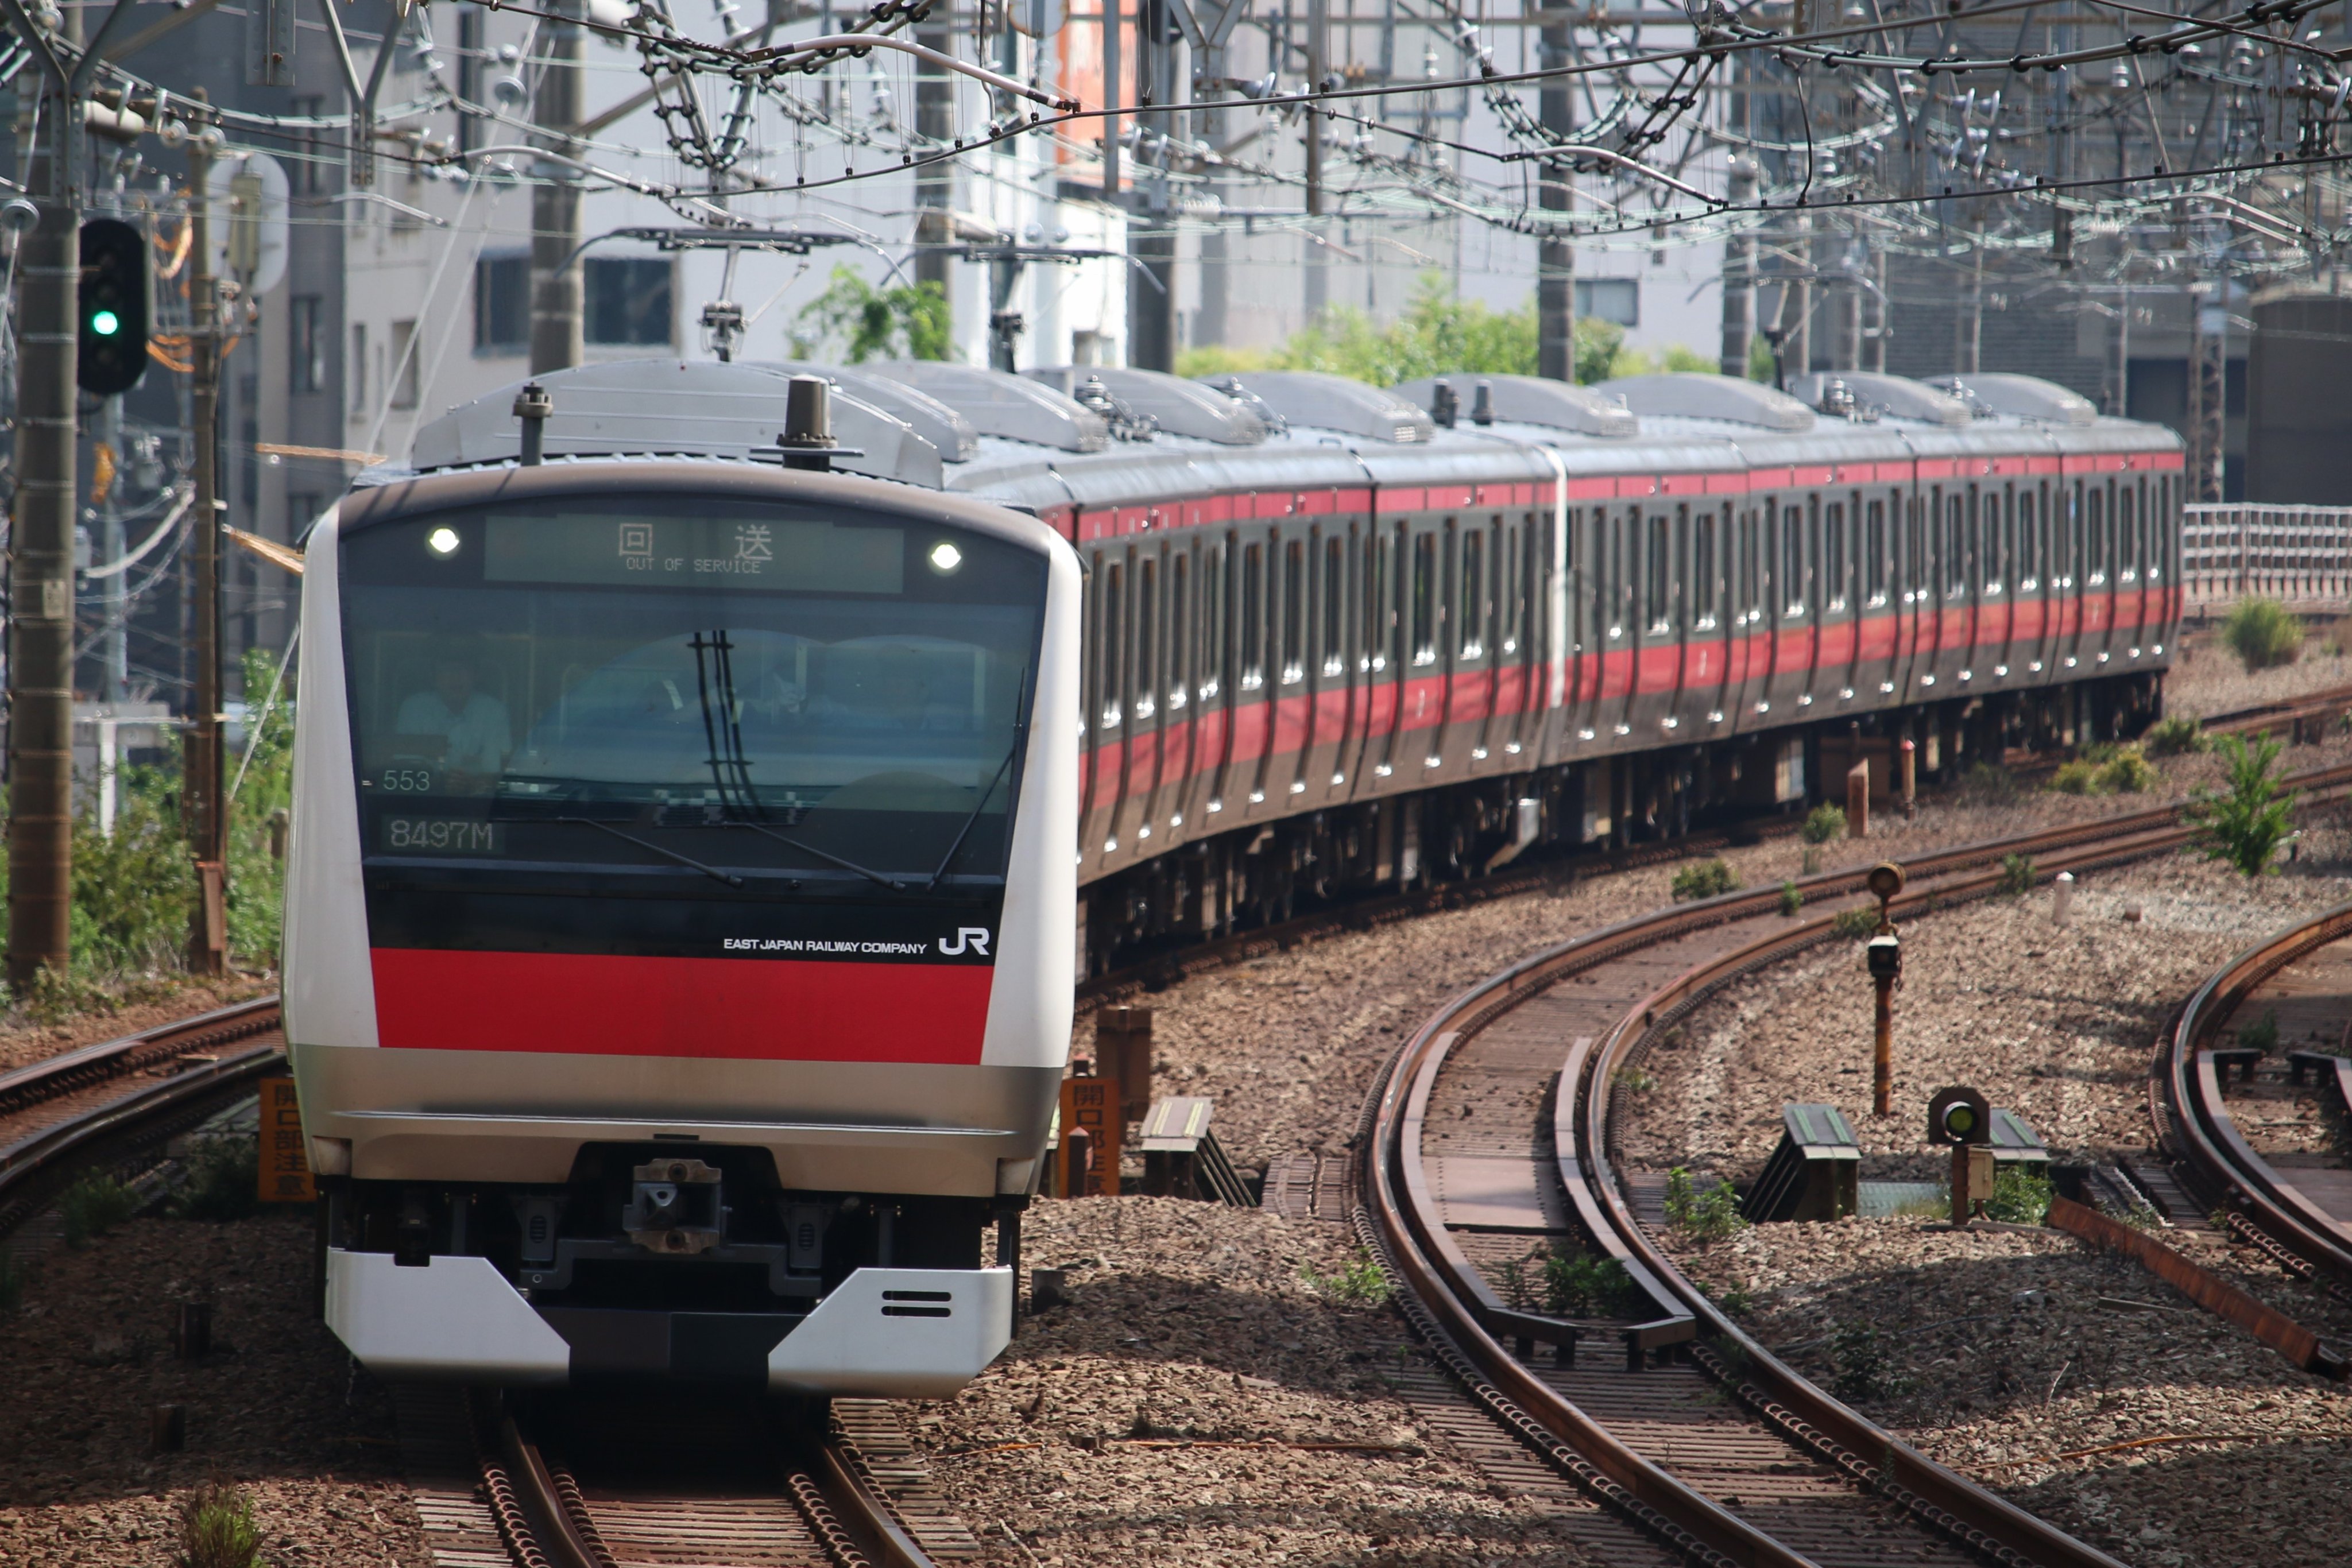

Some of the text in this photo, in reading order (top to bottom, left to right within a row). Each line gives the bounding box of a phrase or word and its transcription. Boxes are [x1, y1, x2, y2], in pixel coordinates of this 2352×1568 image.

[626, 556, 761, 574] OUT OF SERVICE
[383, 769, 430, 791] 553
[390, 819, 493, 850] 8497M
[724, 938, 927, 954] EAST JAPAN RAILWAY COMPANY
[938, 927, 990, 956] JR
